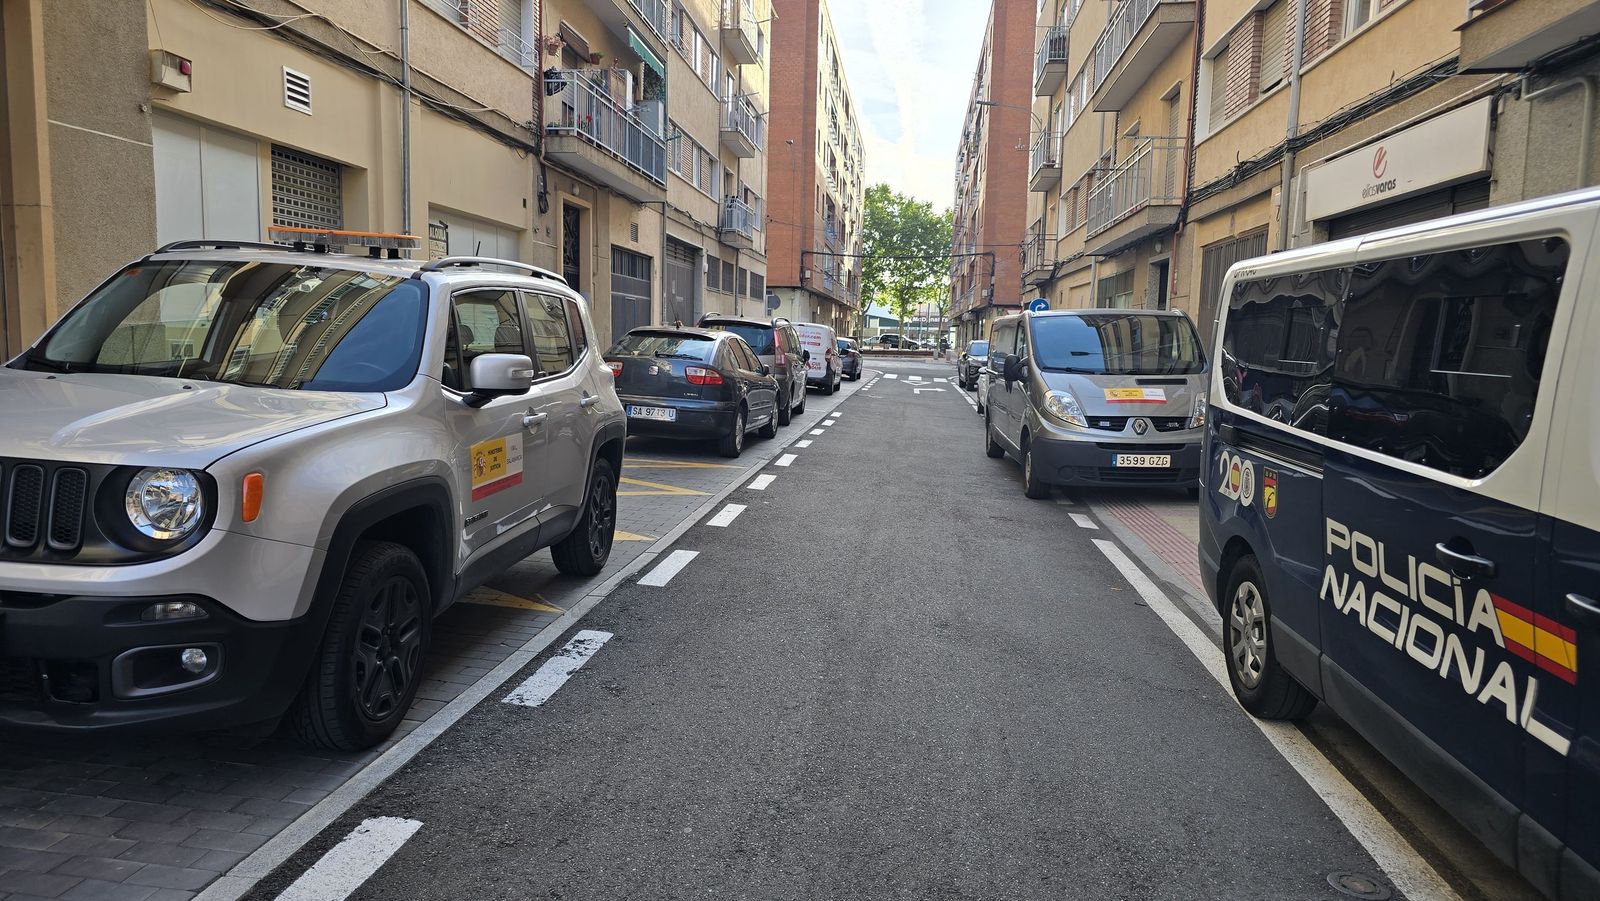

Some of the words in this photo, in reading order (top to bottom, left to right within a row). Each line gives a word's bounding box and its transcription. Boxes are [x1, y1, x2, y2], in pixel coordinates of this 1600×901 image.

[632, 407, 642, 416] SA
[668, 409, 675, 418] U
[1119, 456, 1146, 466] 3599
[1148, 456, 1168, 466] GZG
[1218, 450, 1255, 507] 200
[1319, 564, 1571, 757] NACIONAL
